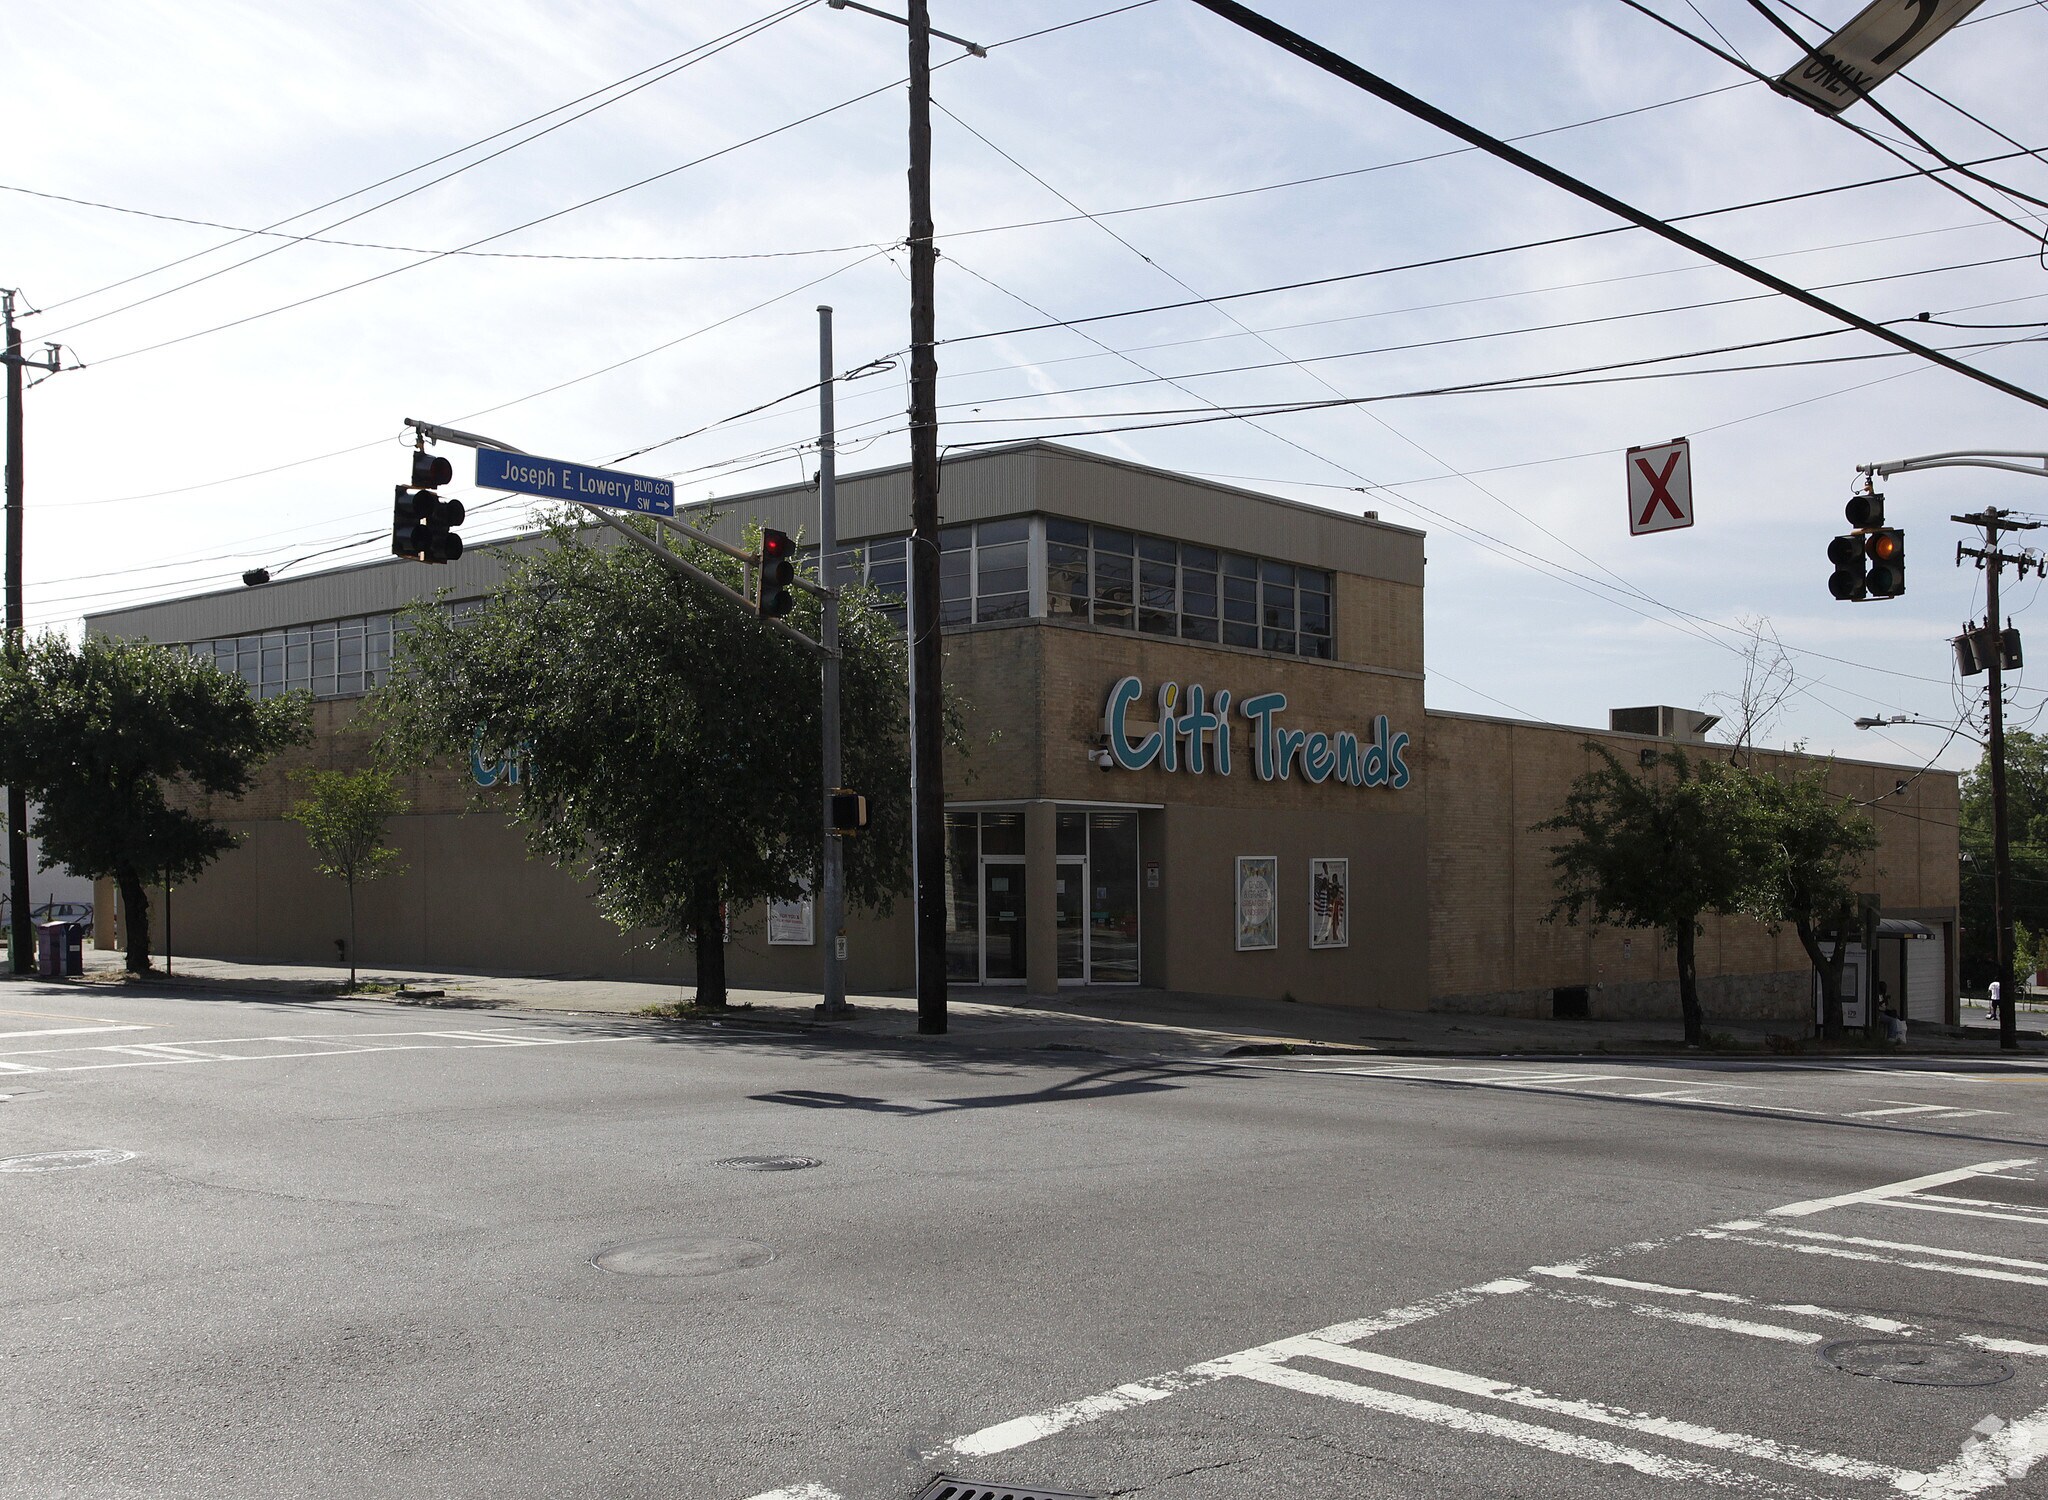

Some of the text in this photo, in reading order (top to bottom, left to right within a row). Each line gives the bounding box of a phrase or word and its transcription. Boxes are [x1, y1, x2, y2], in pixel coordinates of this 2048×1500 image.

[1803, 54, 1873, 97] ONLY
[501, 460, 670, 503] Joseph E. Lowery BLVD 620
[1634, 451, 1685, 526] X
[637, 498, 651, 511] SW
[1104, 676, 1411, 790] Citi Trends
